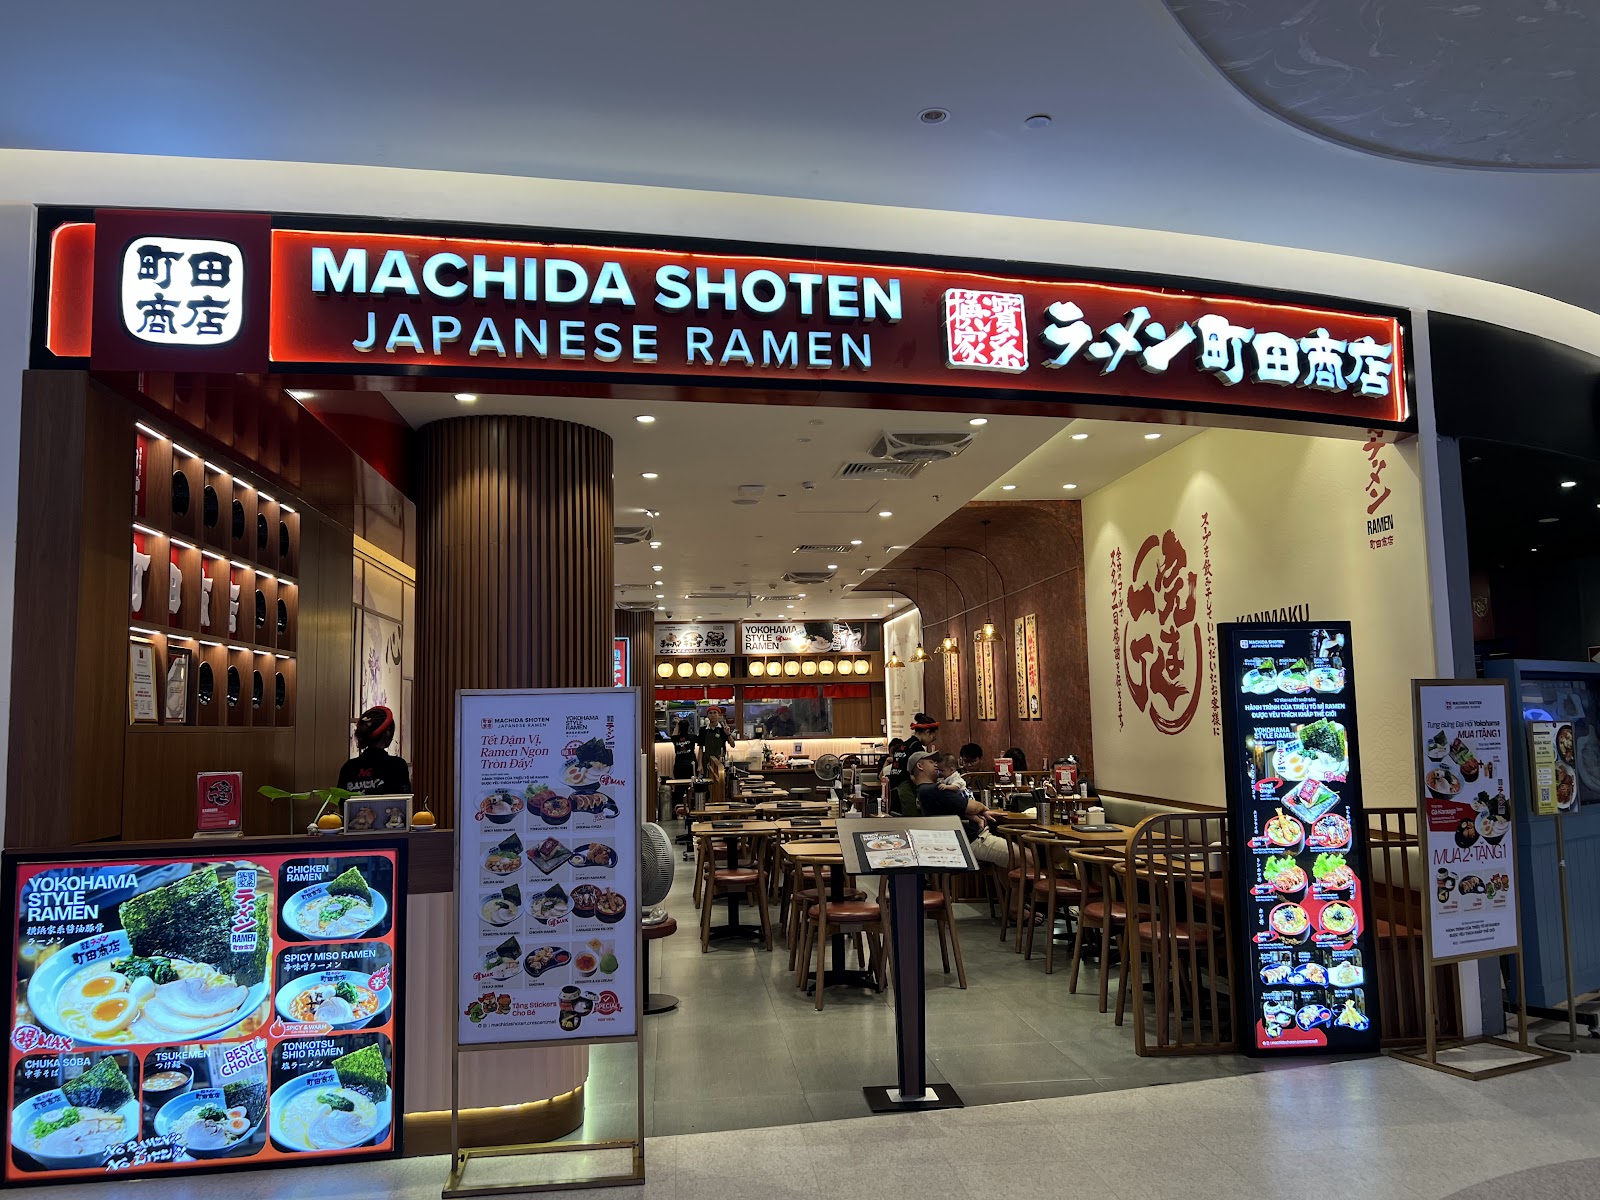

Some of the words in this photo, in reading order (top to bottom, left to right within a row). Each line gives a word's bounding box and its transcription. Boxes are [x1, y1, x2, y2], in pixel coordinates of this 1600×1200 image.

[136, 244, 233, 289] 町田
[311, 247, 636, 306] MACHIDA
[654, 264, 902, 323] SHOTEN
[136, 292, 231, 336] 商店
[352, 311, 658, 363] JAPANESE
[686, 325, 872, 371] RAMEN
[1367, 514, 1394, 535] RAMEN
[746, 626, 797, 634] YOKOHAMA
[481, 734, 498, 746] Tết
[500, 735, 526, 747] Đậm
[480, 747, 518, 758] Ramen
[520, 746, 549, 759] Ngon
[481, 759, 506, 769] Tròn
[286, 865, 329, 874] CHICKEN
[28, 874, 138, 892] YOKOHAMA
[286, 873, 322, 882] RAMEN
[28, 891, 86, 907] STYLE
[28, 904, 99, 922] RAMEN
[232, 934, 256, 943] RAMEN
[72, 940, 120, 965] 町田商店
[284, 953, 312, 962] SPICY
[315, 952, 339, 961] MISO
[341, 950, 376, 959] RAMEN
[226, 1040, 254, 1062] BEST
[282, 1040, 334, 1051] TONKOTSU
[155, 1050, 211, 1061] TSUKEMEN
[282, 1050, 306, 1059] SHIO
[307, 1047, 344, 1058] RAMEN
[24, 1060, 60, 1069] CHUKA
[63, 1058, 91, 1067] SOBA
[221, 1051, 266, 1076] CHOICE
